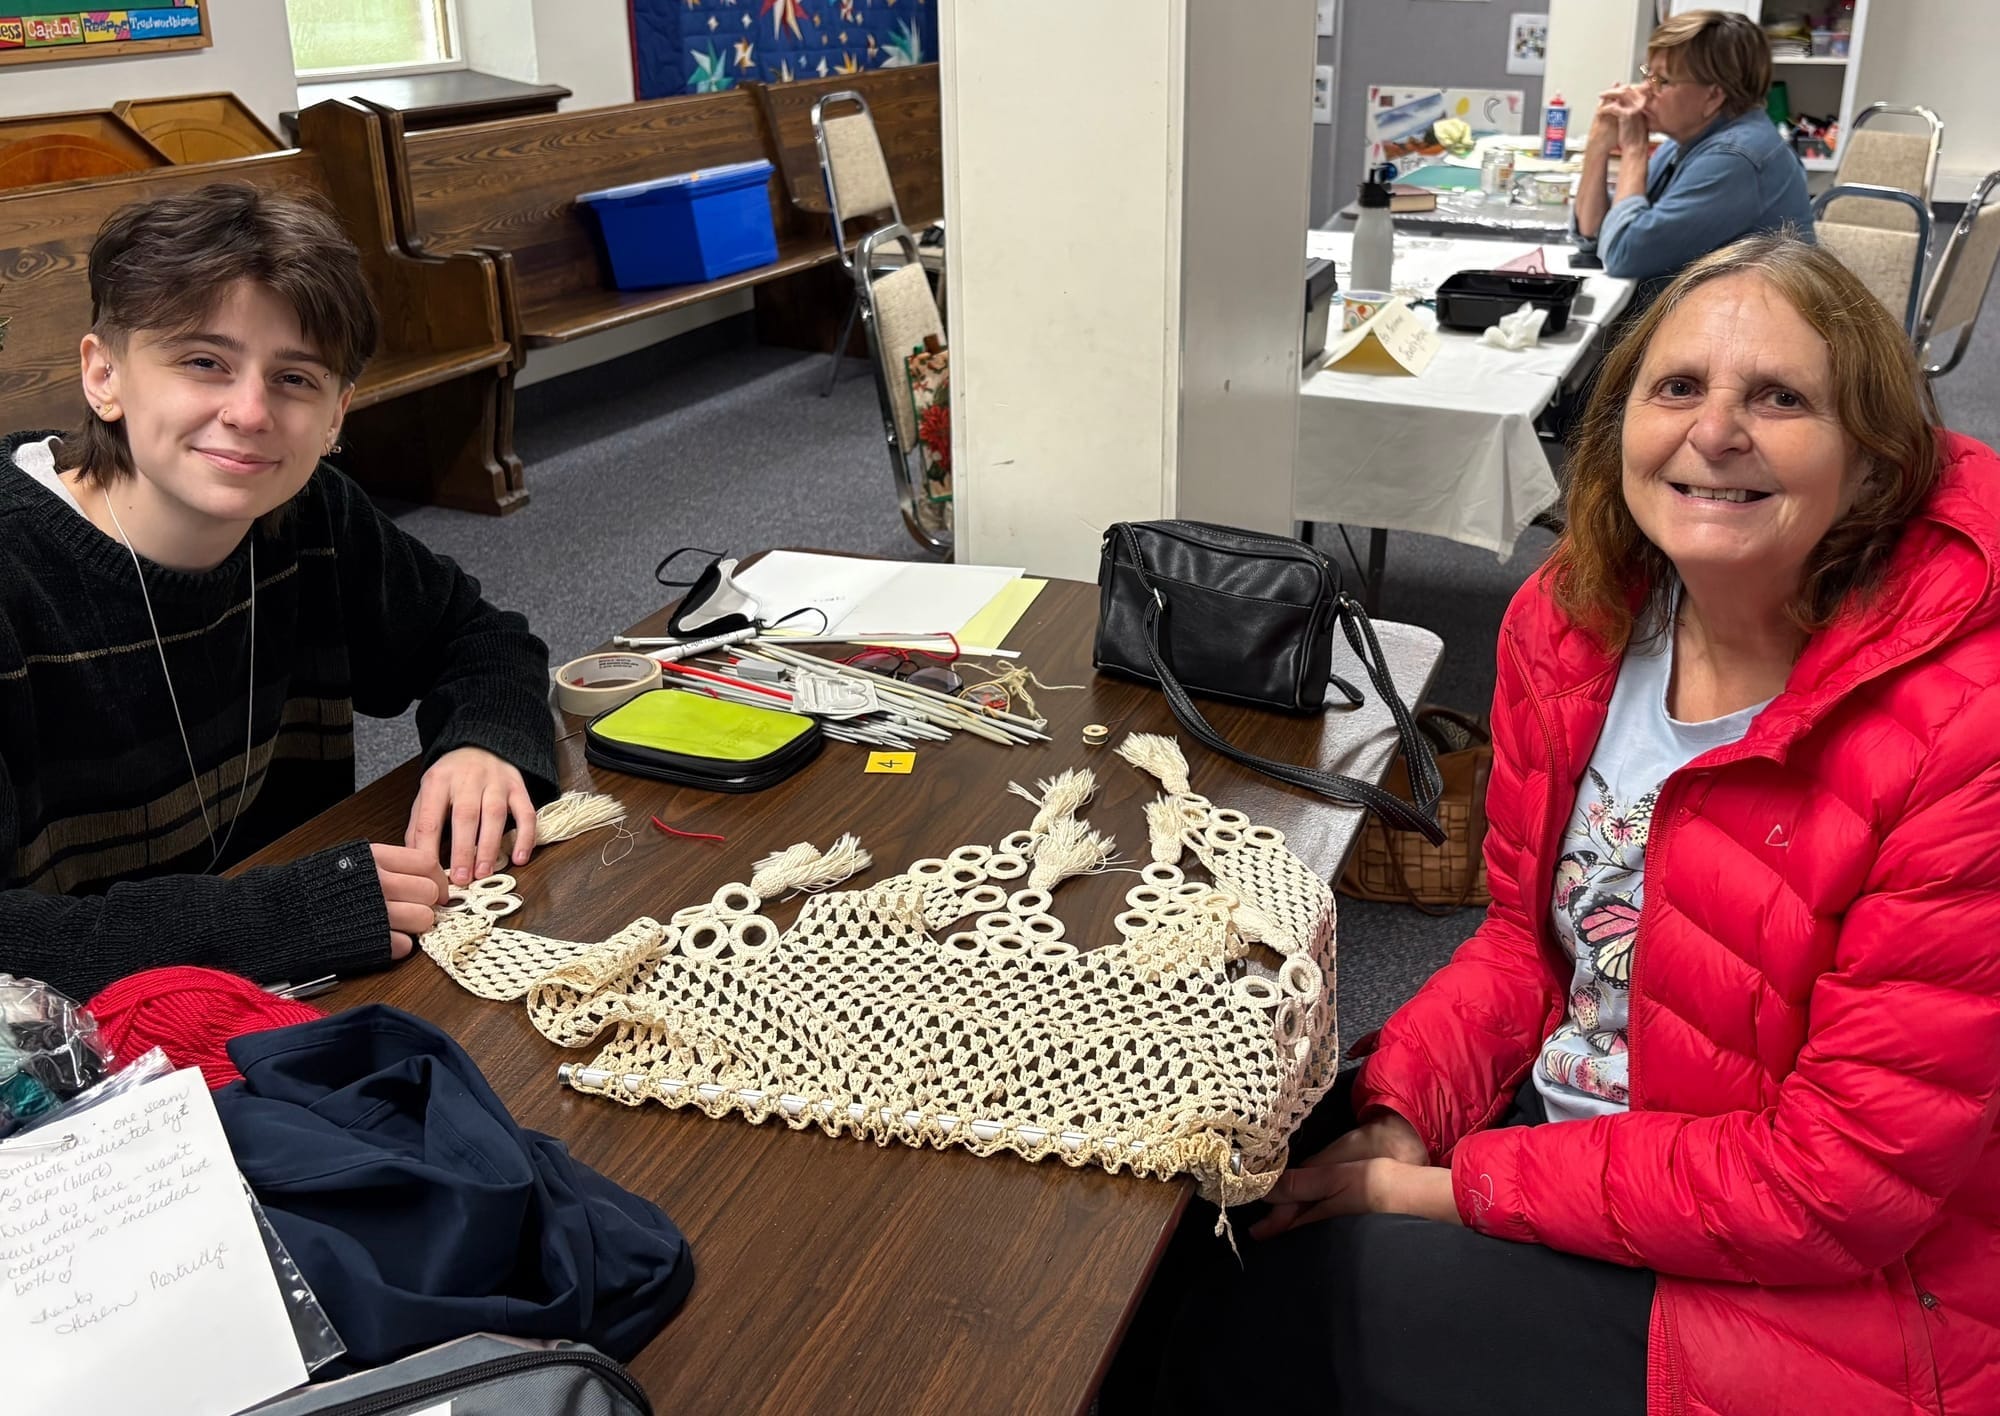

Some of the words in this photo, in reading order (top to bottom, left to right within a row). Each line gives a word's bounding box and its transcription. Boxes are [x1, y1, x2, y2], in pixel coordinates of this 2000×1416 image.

[877, 759, 903, 769] 4
[113, 1112, 137, 1130] one
[8, 1197, 22, 1212] 2
[63, 1161, 113, 1193] (black)
[42, 1212, 97, 1245] which
[103, 1193, 142, 1215] was
[59, 1202, 78, 1216] as
[118, 1183, 200, 1227] included
